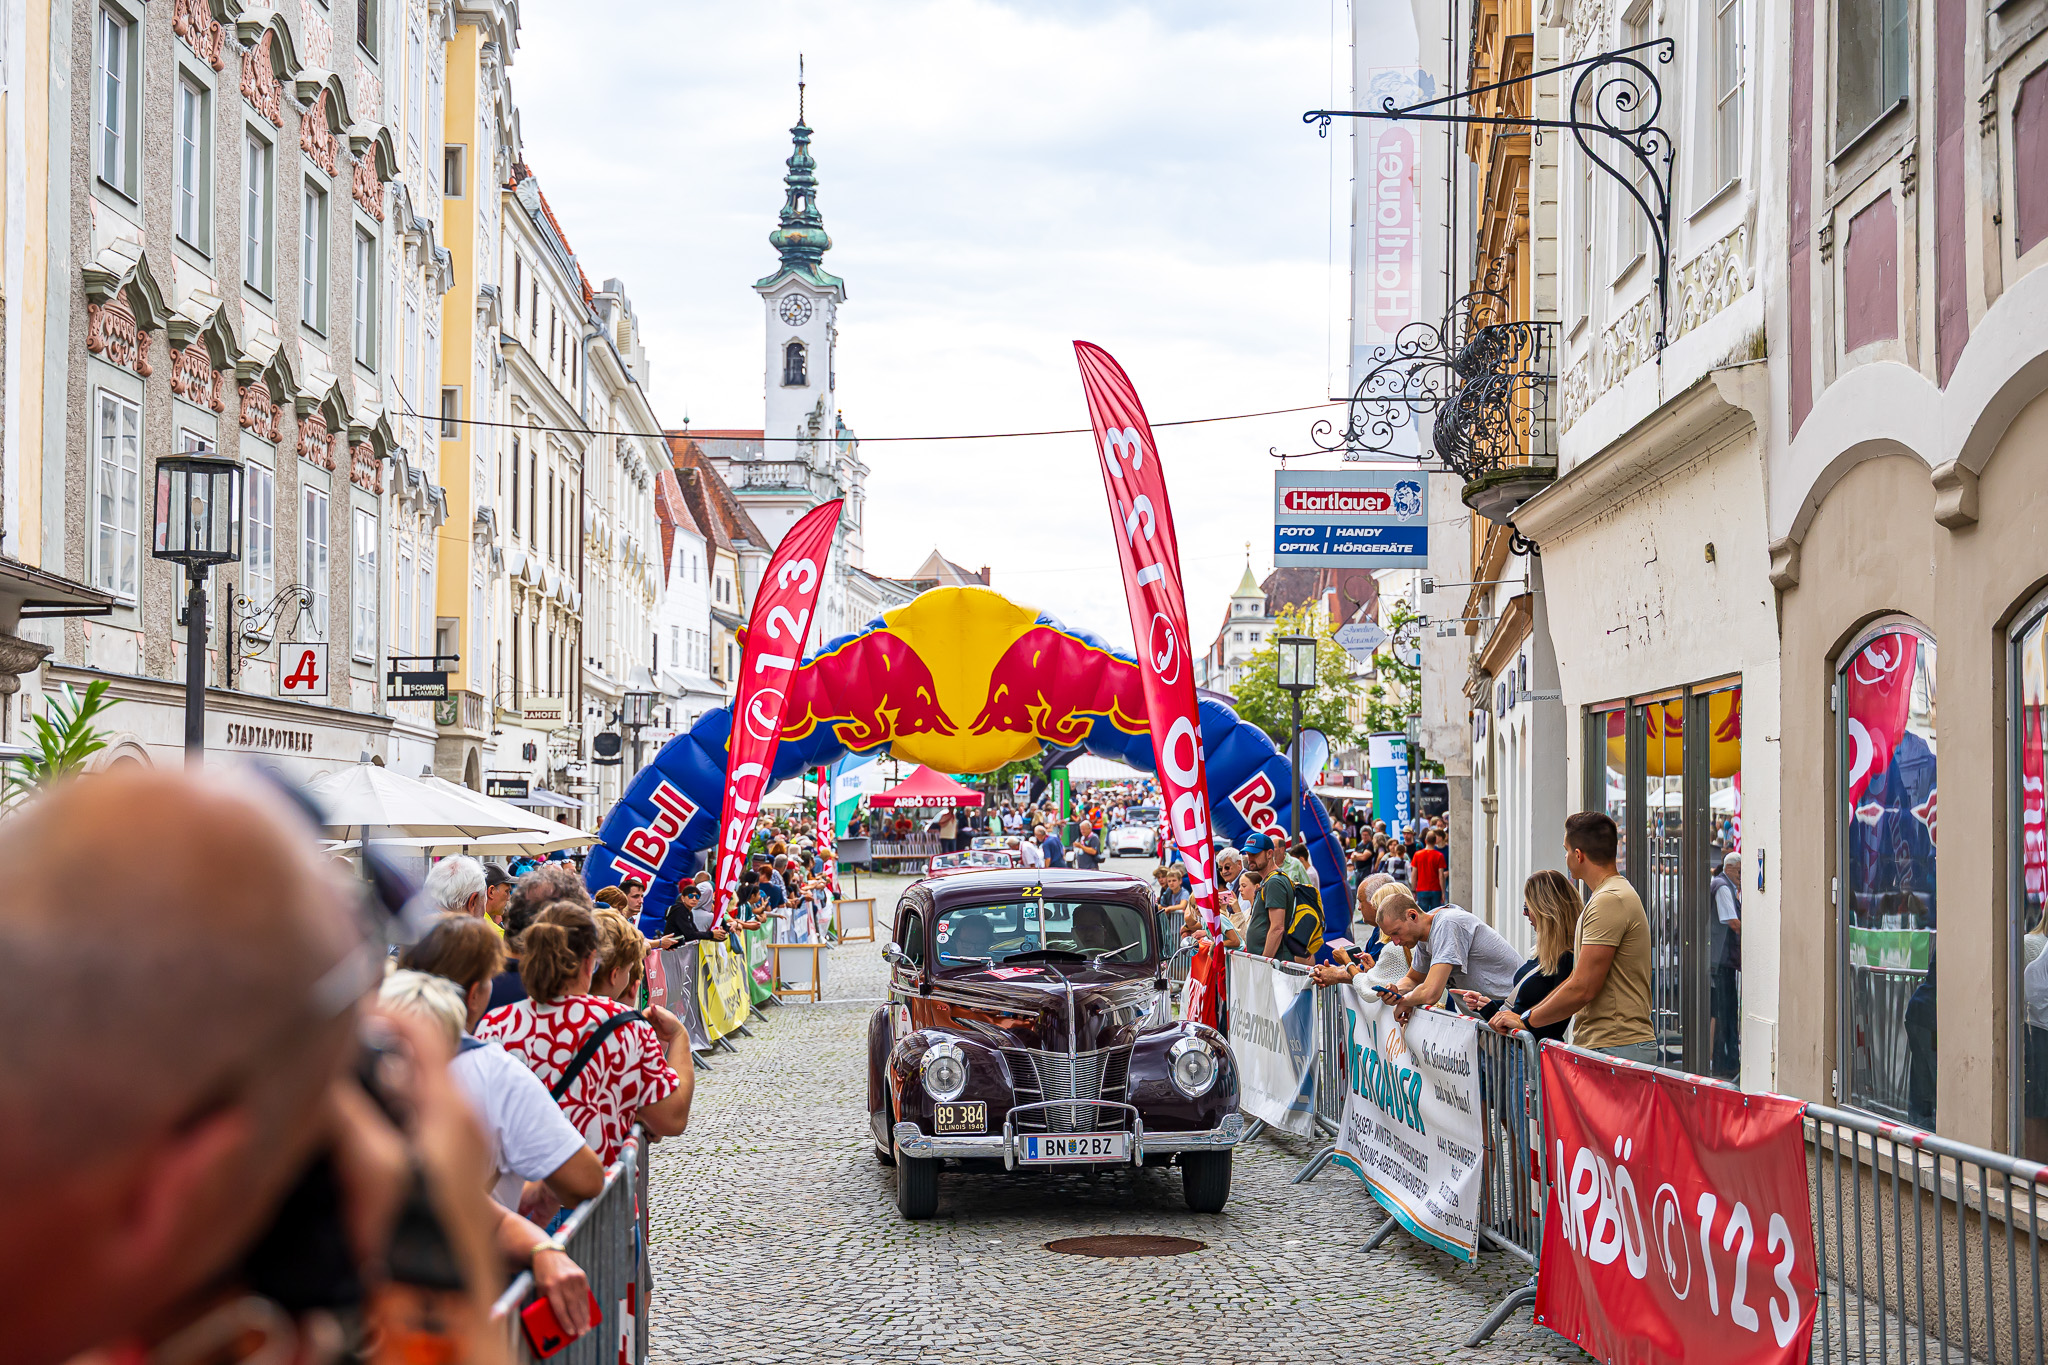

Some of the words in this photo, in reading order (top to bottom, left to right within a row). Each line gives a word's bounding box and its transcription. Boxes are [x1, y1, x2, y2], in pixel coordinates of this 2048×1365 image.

[1292, 492, 1384, 511] Hartlauer
[1279, 527, 1315, 537] FOTO
[1335, 528, 1383, 537] HANDY
[1279, 543, 1319, 552] OPTIK
[1333, 542, 1413, 553] HÖRGERÄTE
[755, 556, 818, 676] 123
[1341, 636, 1379, 645] Alexander
[411, 684, 445, 692] SCHWING
[227, 722, 314, 753] STADTAPOTHEKE
[894, 795, 924, 807] ARBÖ
[935, 797, 957, 807] 123
[623, 783, 697, 869] Bull
[1022, 887, 1043, 897] 22
[937, 1106, 954, 1124] 89
[959, 1105, 984, 1124] 384
[1046, 1139, 1066, 1156] BN
[1555, 1135, 1648, 1280] ARBÖ
[1696, 1191, 1801, 1348] 123
